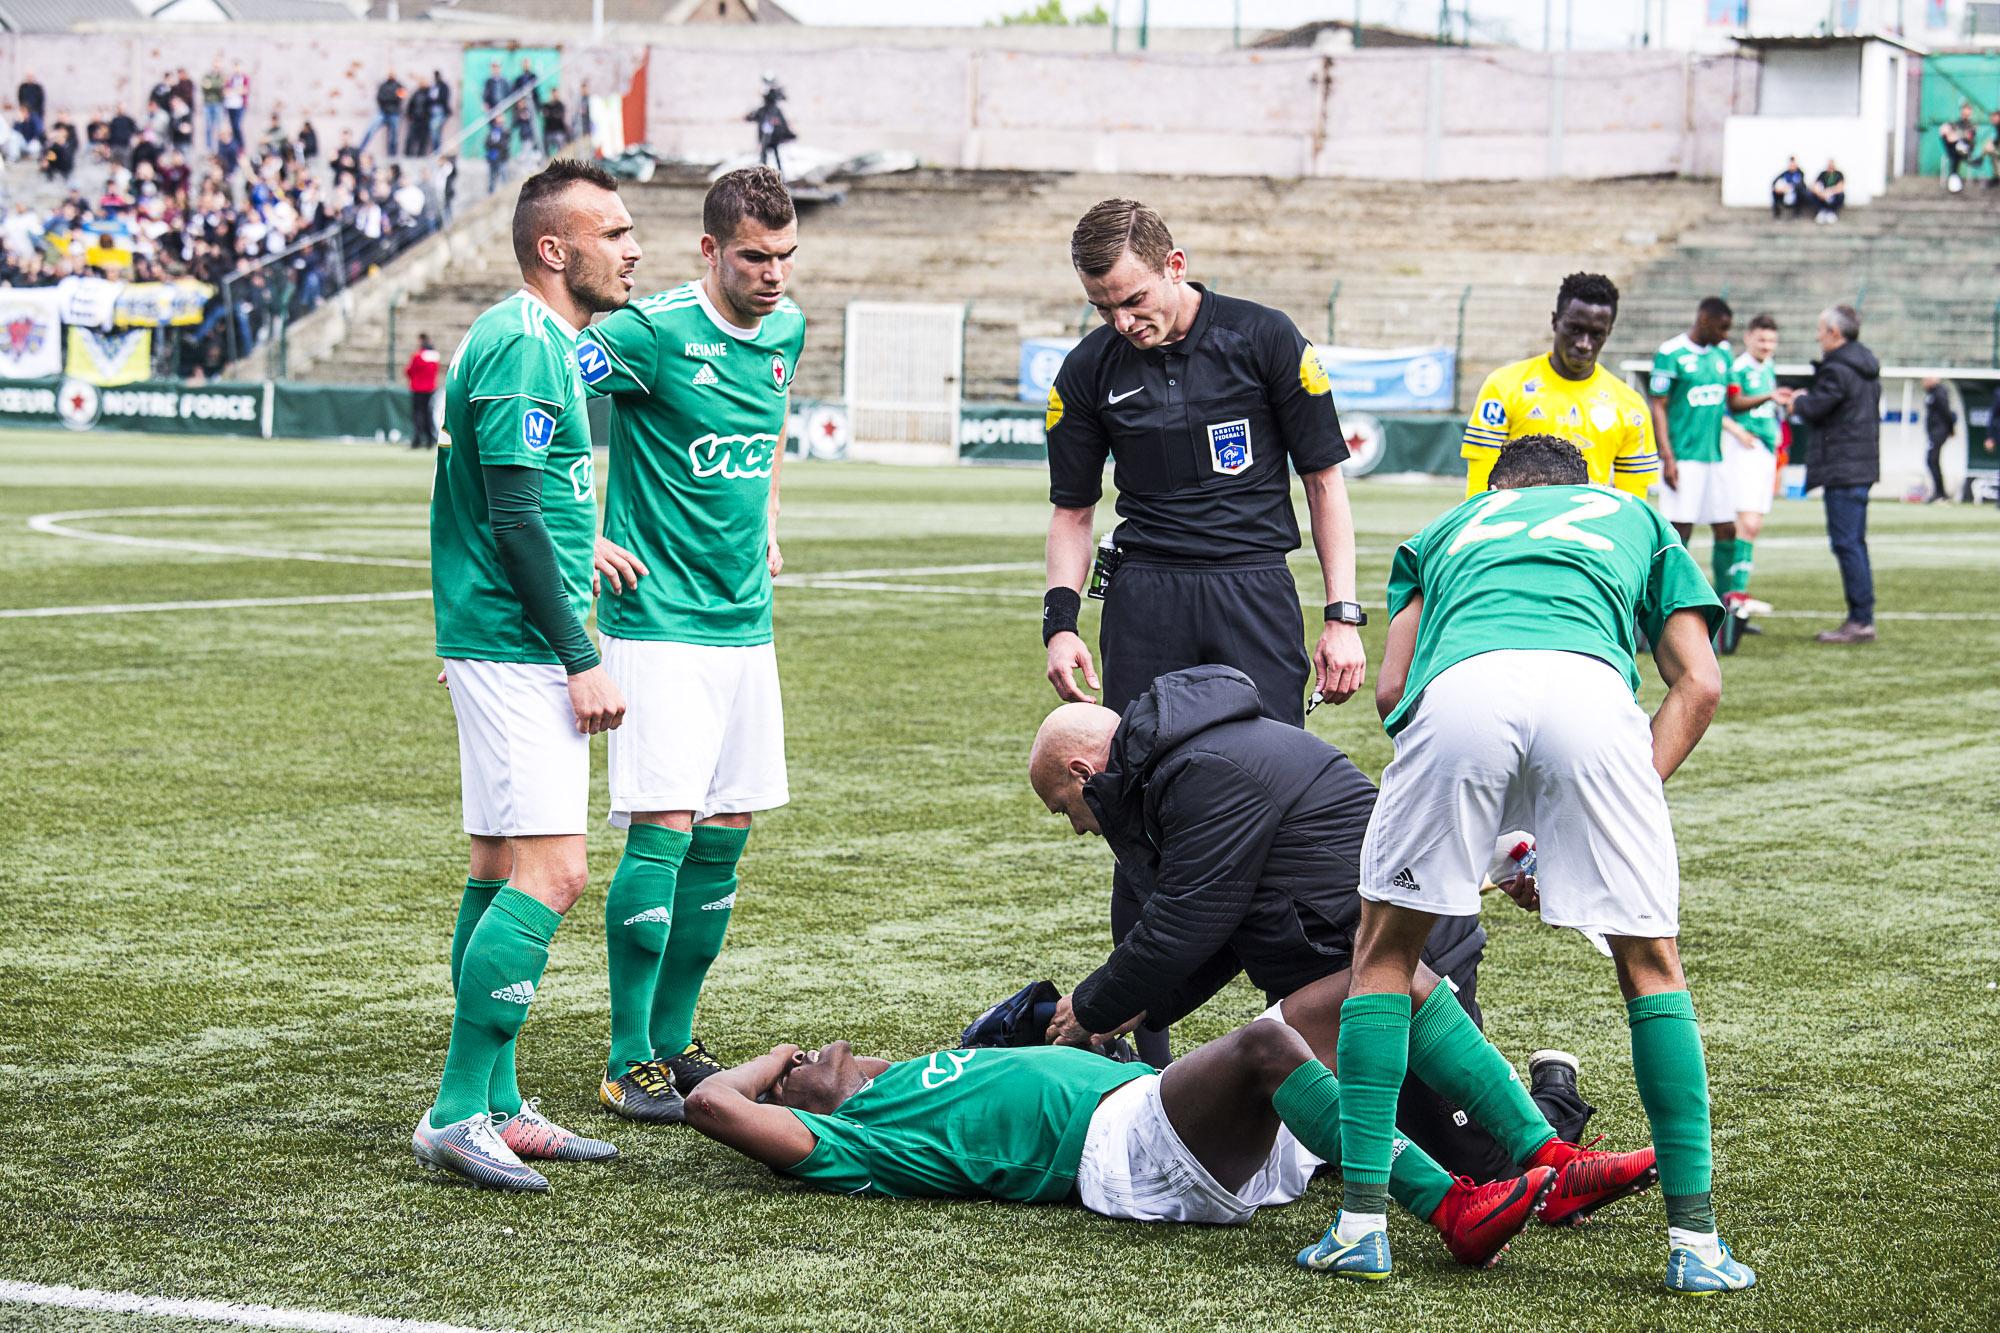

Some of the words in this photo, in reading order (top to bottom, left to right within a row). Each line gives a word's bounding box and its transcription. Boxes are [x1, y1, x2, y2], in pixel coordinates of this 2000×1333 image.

[580, 348, 605, 374] N
[692, 376, 719, 385] adidas
[103, 391, 178, 418] NOTRE
[180, 394, 256, 421] FORCE
[529, 414, 545, 439] N
[961, 418, 1045, 445] NOTRE
[1214, 426, 1243, 435] ARBITRE
[1447, 488, 1621, 556] 22
[1393, 879, 1421, 891] adidas
